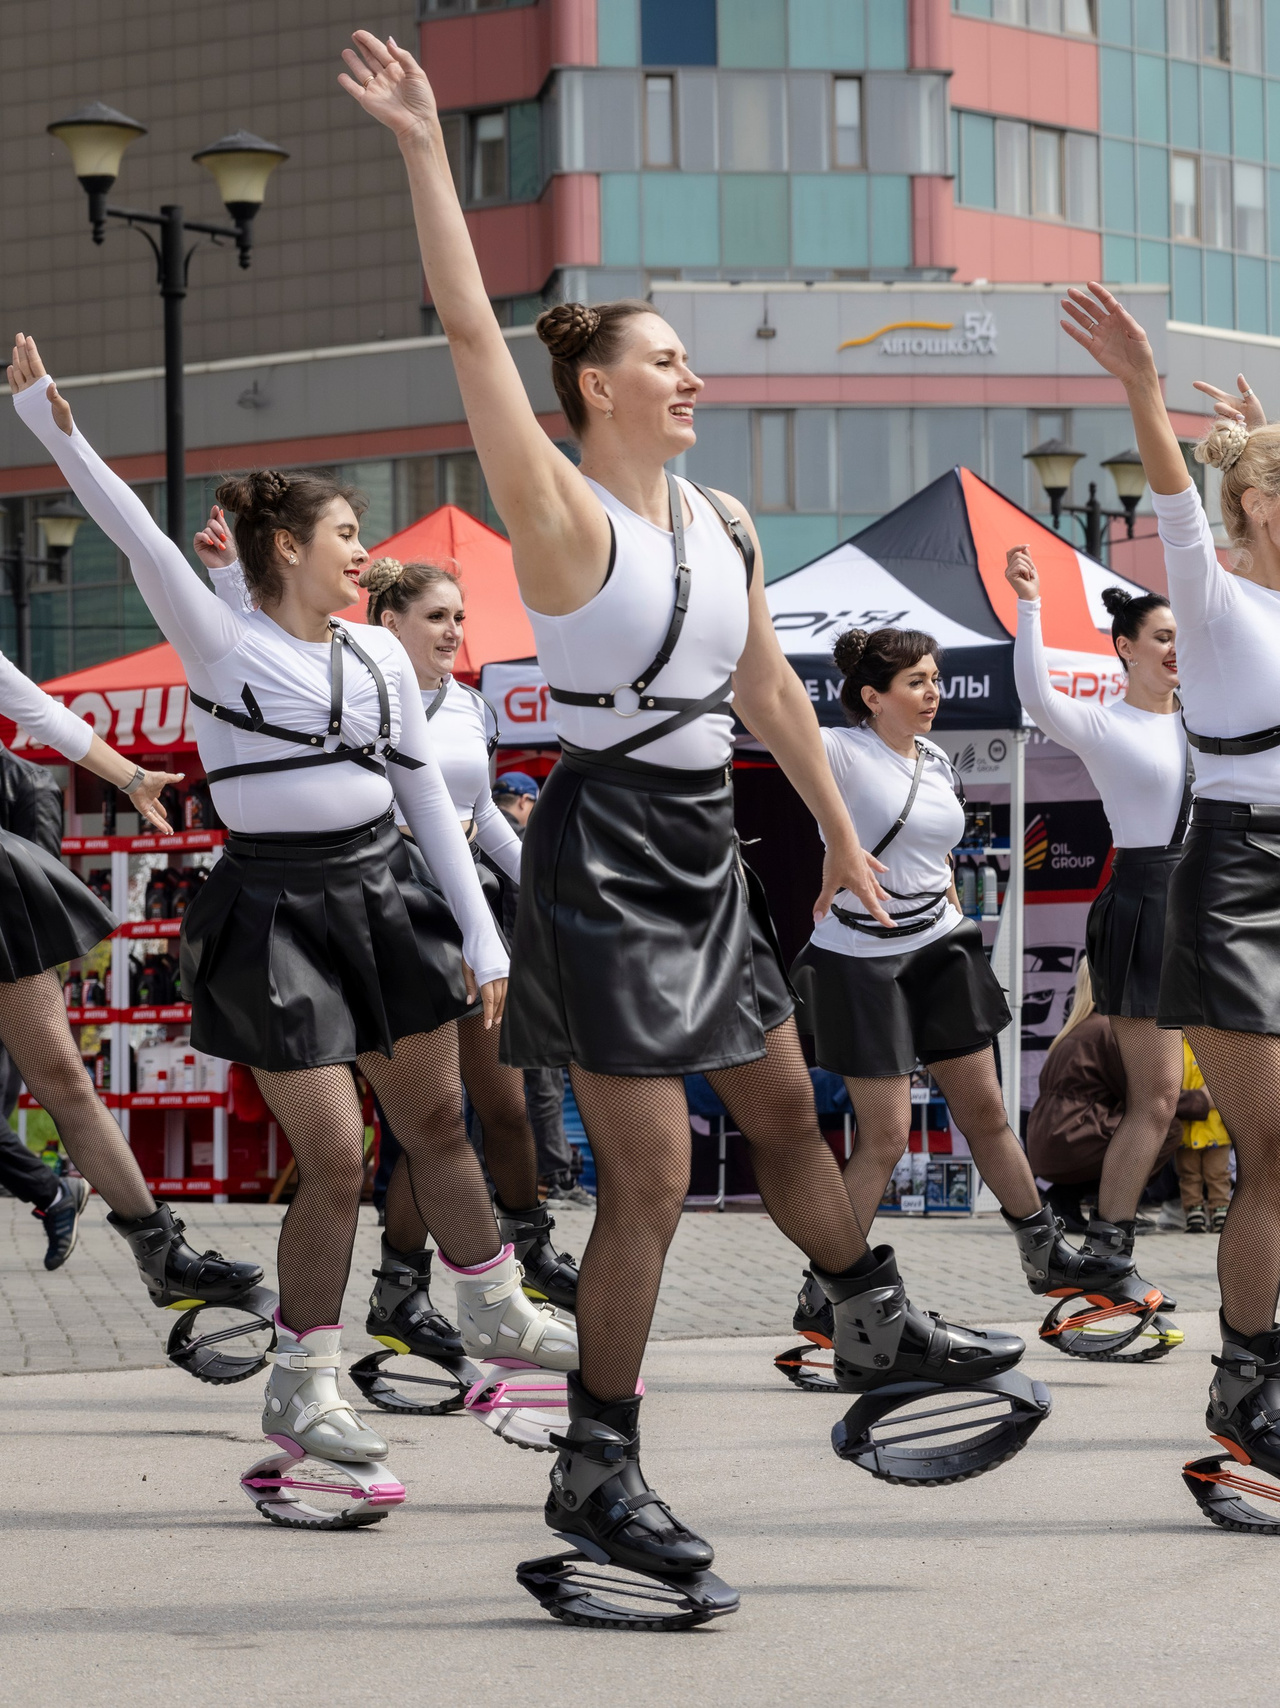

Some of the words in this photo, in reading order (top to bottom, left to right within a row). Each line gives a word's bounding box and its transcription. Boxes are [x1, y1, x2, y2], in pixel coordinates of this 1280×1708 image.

[964, 311, 998, 340] 54
[880, 338, 998, 356] АВТОШКОЛА
[10, 685, 198, 750] OTU
[1051, 842, 1071, 855] OIL
[1051, 854, 1096, 870] GROUP
